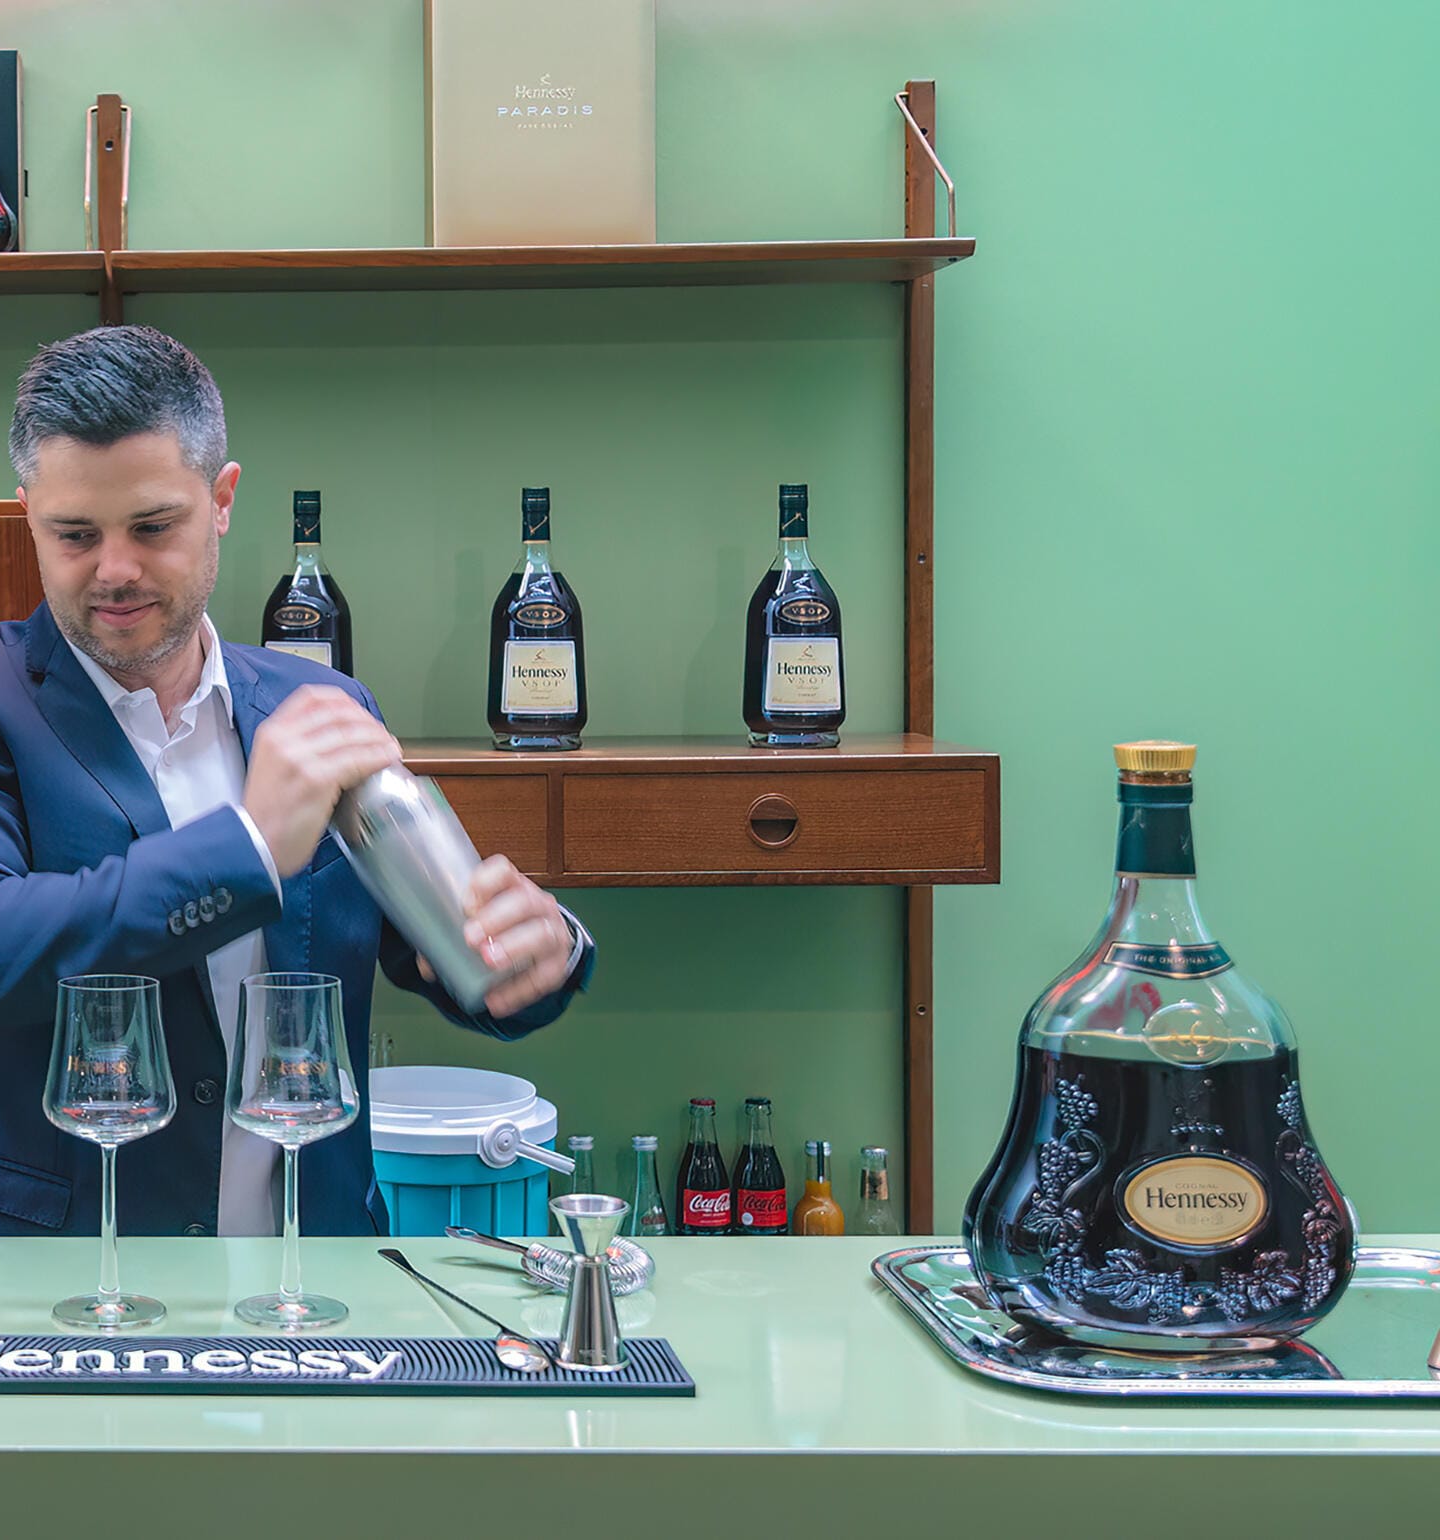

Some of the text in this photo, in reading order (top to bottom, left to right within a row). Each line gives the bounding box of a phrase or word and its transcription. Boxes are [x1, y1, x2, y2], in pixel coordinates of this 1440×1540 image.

[515, 84, 576, 101] Hennessy
[496, 104, 594, 117] PARADIS
[512, 666, 568, 679] Hennessy
[777, 662, 832, 677] Hennessy
[1145, 1187, 1249, 1213] Hennessy
